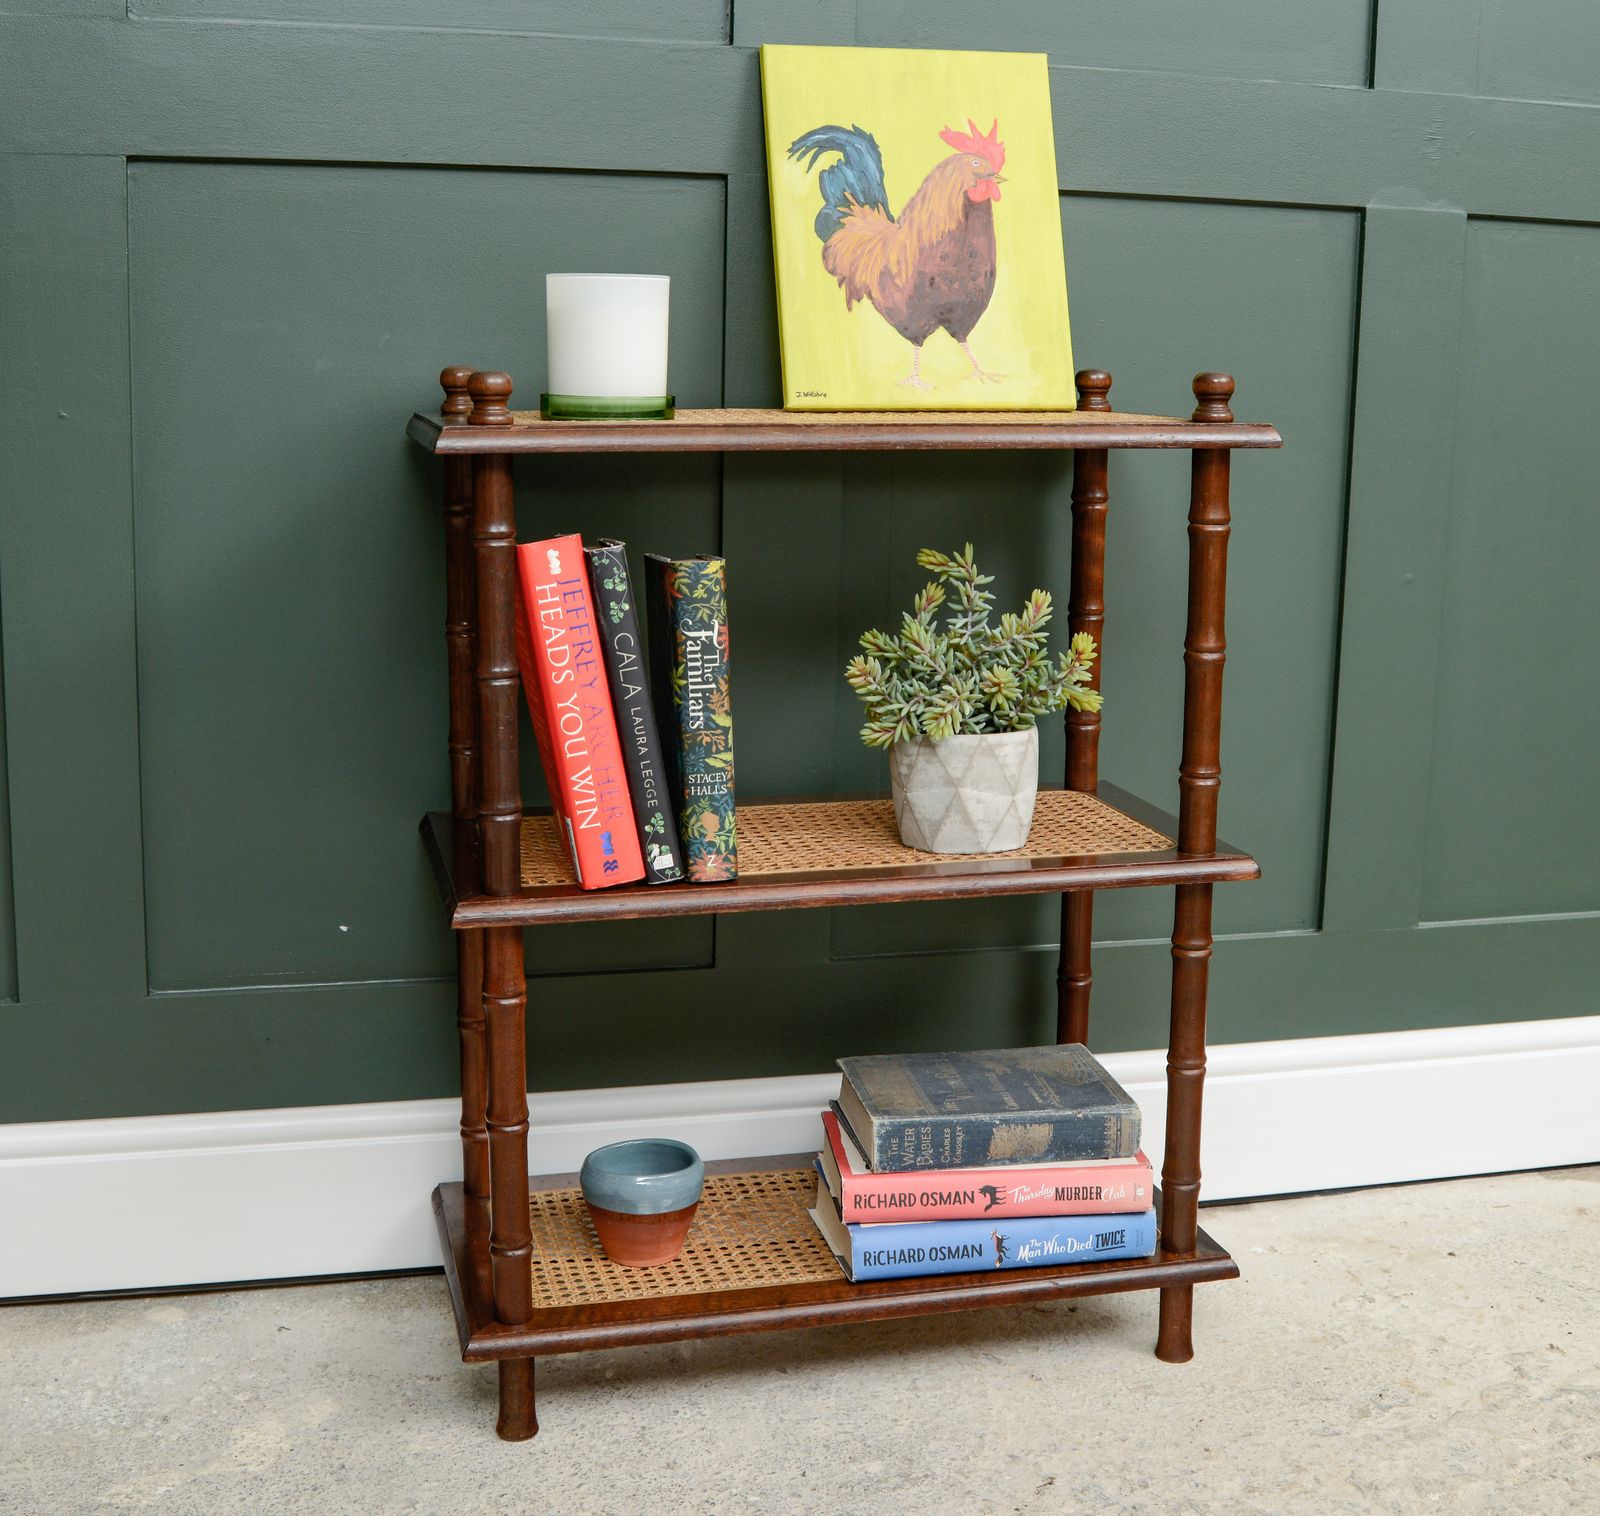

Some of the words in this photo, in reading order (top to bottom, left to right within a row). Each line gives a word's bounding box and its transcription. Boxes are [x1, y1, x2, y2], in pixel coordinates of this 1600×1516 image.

[535, 582, 575, 684] HEADS
[680, 619, 725, 729] Familiars
[703, 649, 720, 682] The
[556, 578, 600, 691] JEFFREY
[584, 703, 624, 825] ARCHER
[556, 692, 588, 759] YOU
[614, 632, 642, 700] CALA
[630, 707, 649, 755] LAURA
[640, 760, 659, 807] LEGGE
[688, 772, 728, 784] STACEY
[570, 765, 602, 830] WIN
[691, 784, 728, 796] HALLS
[707, 854, 716, 867] Z
[888, 1136, 899, 1157] THE
[901, 1127, 915, 1167] WATER
[916, 1126, 934, 1167] BABIES
[940, 1127, 951, 1164] CHARLES
[952, 1126, 964, 1164] KINGSLEY
[920, 1190, 975, 1207] OSMAN
[1007, 1183, 1057, 1204] Thursday
[1023, 1185, 1032, 1194] The
[1054, 1186, 1102, 1202] MURDER
[1101, 1184, 1126, 1202] Club
[1029, 1239, 1042, 1248] The
[1043, 1234, 1067, 1256] Who
[1067, 1234, 1093, 1254] Died
[1095, 1229, 1126, 1250] TWICE
[928, 1243, 983, 1262] OSMAN
[1016, 1244, 1041, 1264] Man
